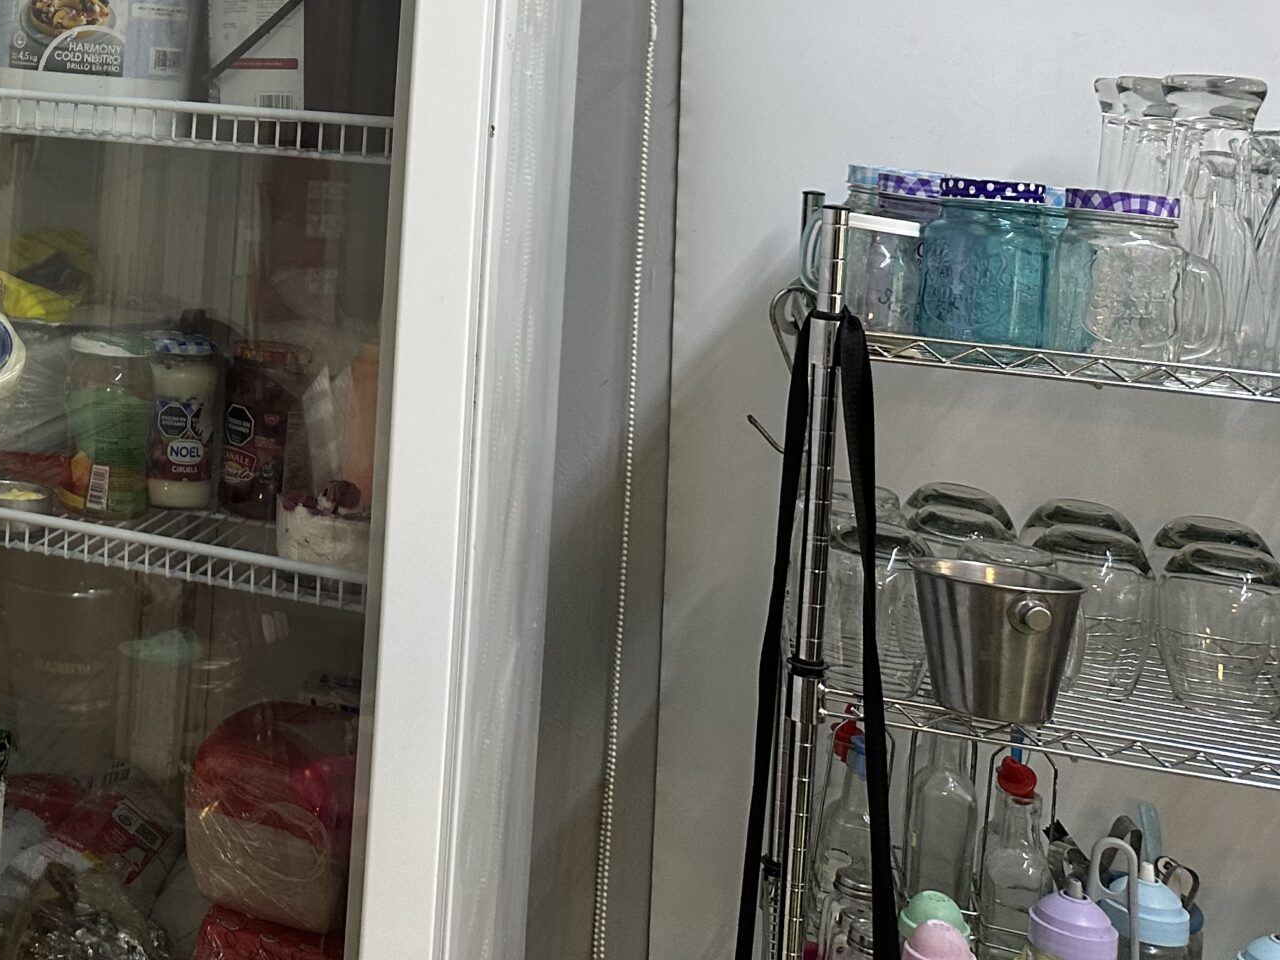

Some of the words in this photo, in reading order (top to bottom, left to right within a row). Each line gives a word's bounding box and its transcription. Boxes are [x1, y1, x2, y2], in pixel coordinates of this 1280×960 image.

[68, 41, 122, 55] HARMONY
[54, 50, 85, 62] COLD
[84, 53, 121, 66] NEUTRO
[66, 61, 91, 71] BRILLO
[169, 445, 201, 458] NOEL
[171, 465, 198, 474] CIRUELA
